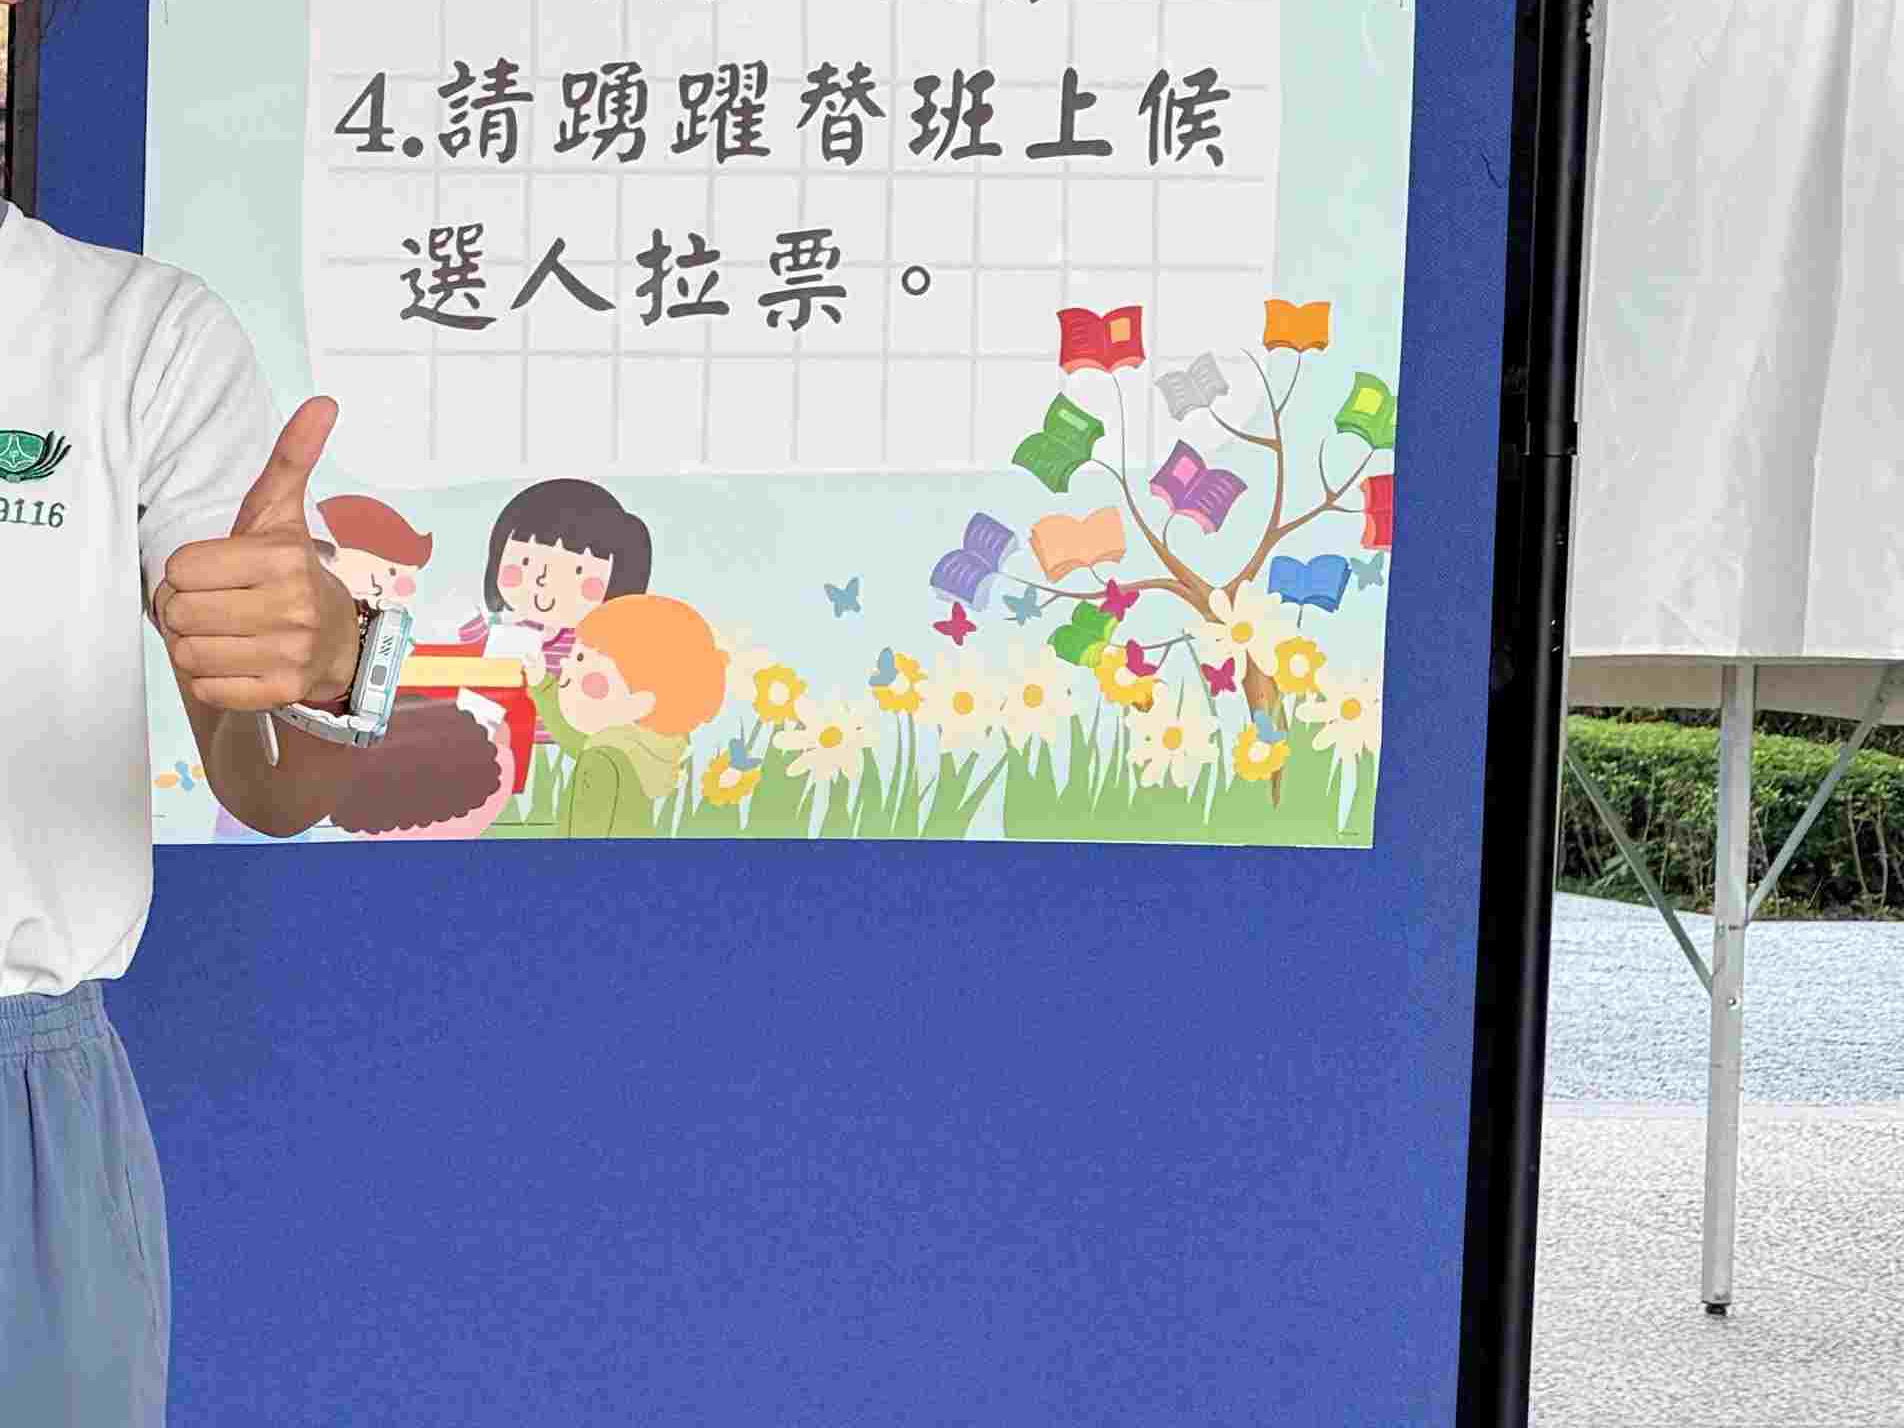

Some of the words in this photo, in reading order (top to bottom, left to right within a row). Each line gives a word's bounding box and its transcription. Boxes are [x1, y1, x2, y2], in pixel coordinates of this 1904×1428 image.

[333, 57, 1231, 169] 4.請踴躍替班上候
[398, 222, 932, 333] 選人拉票。
